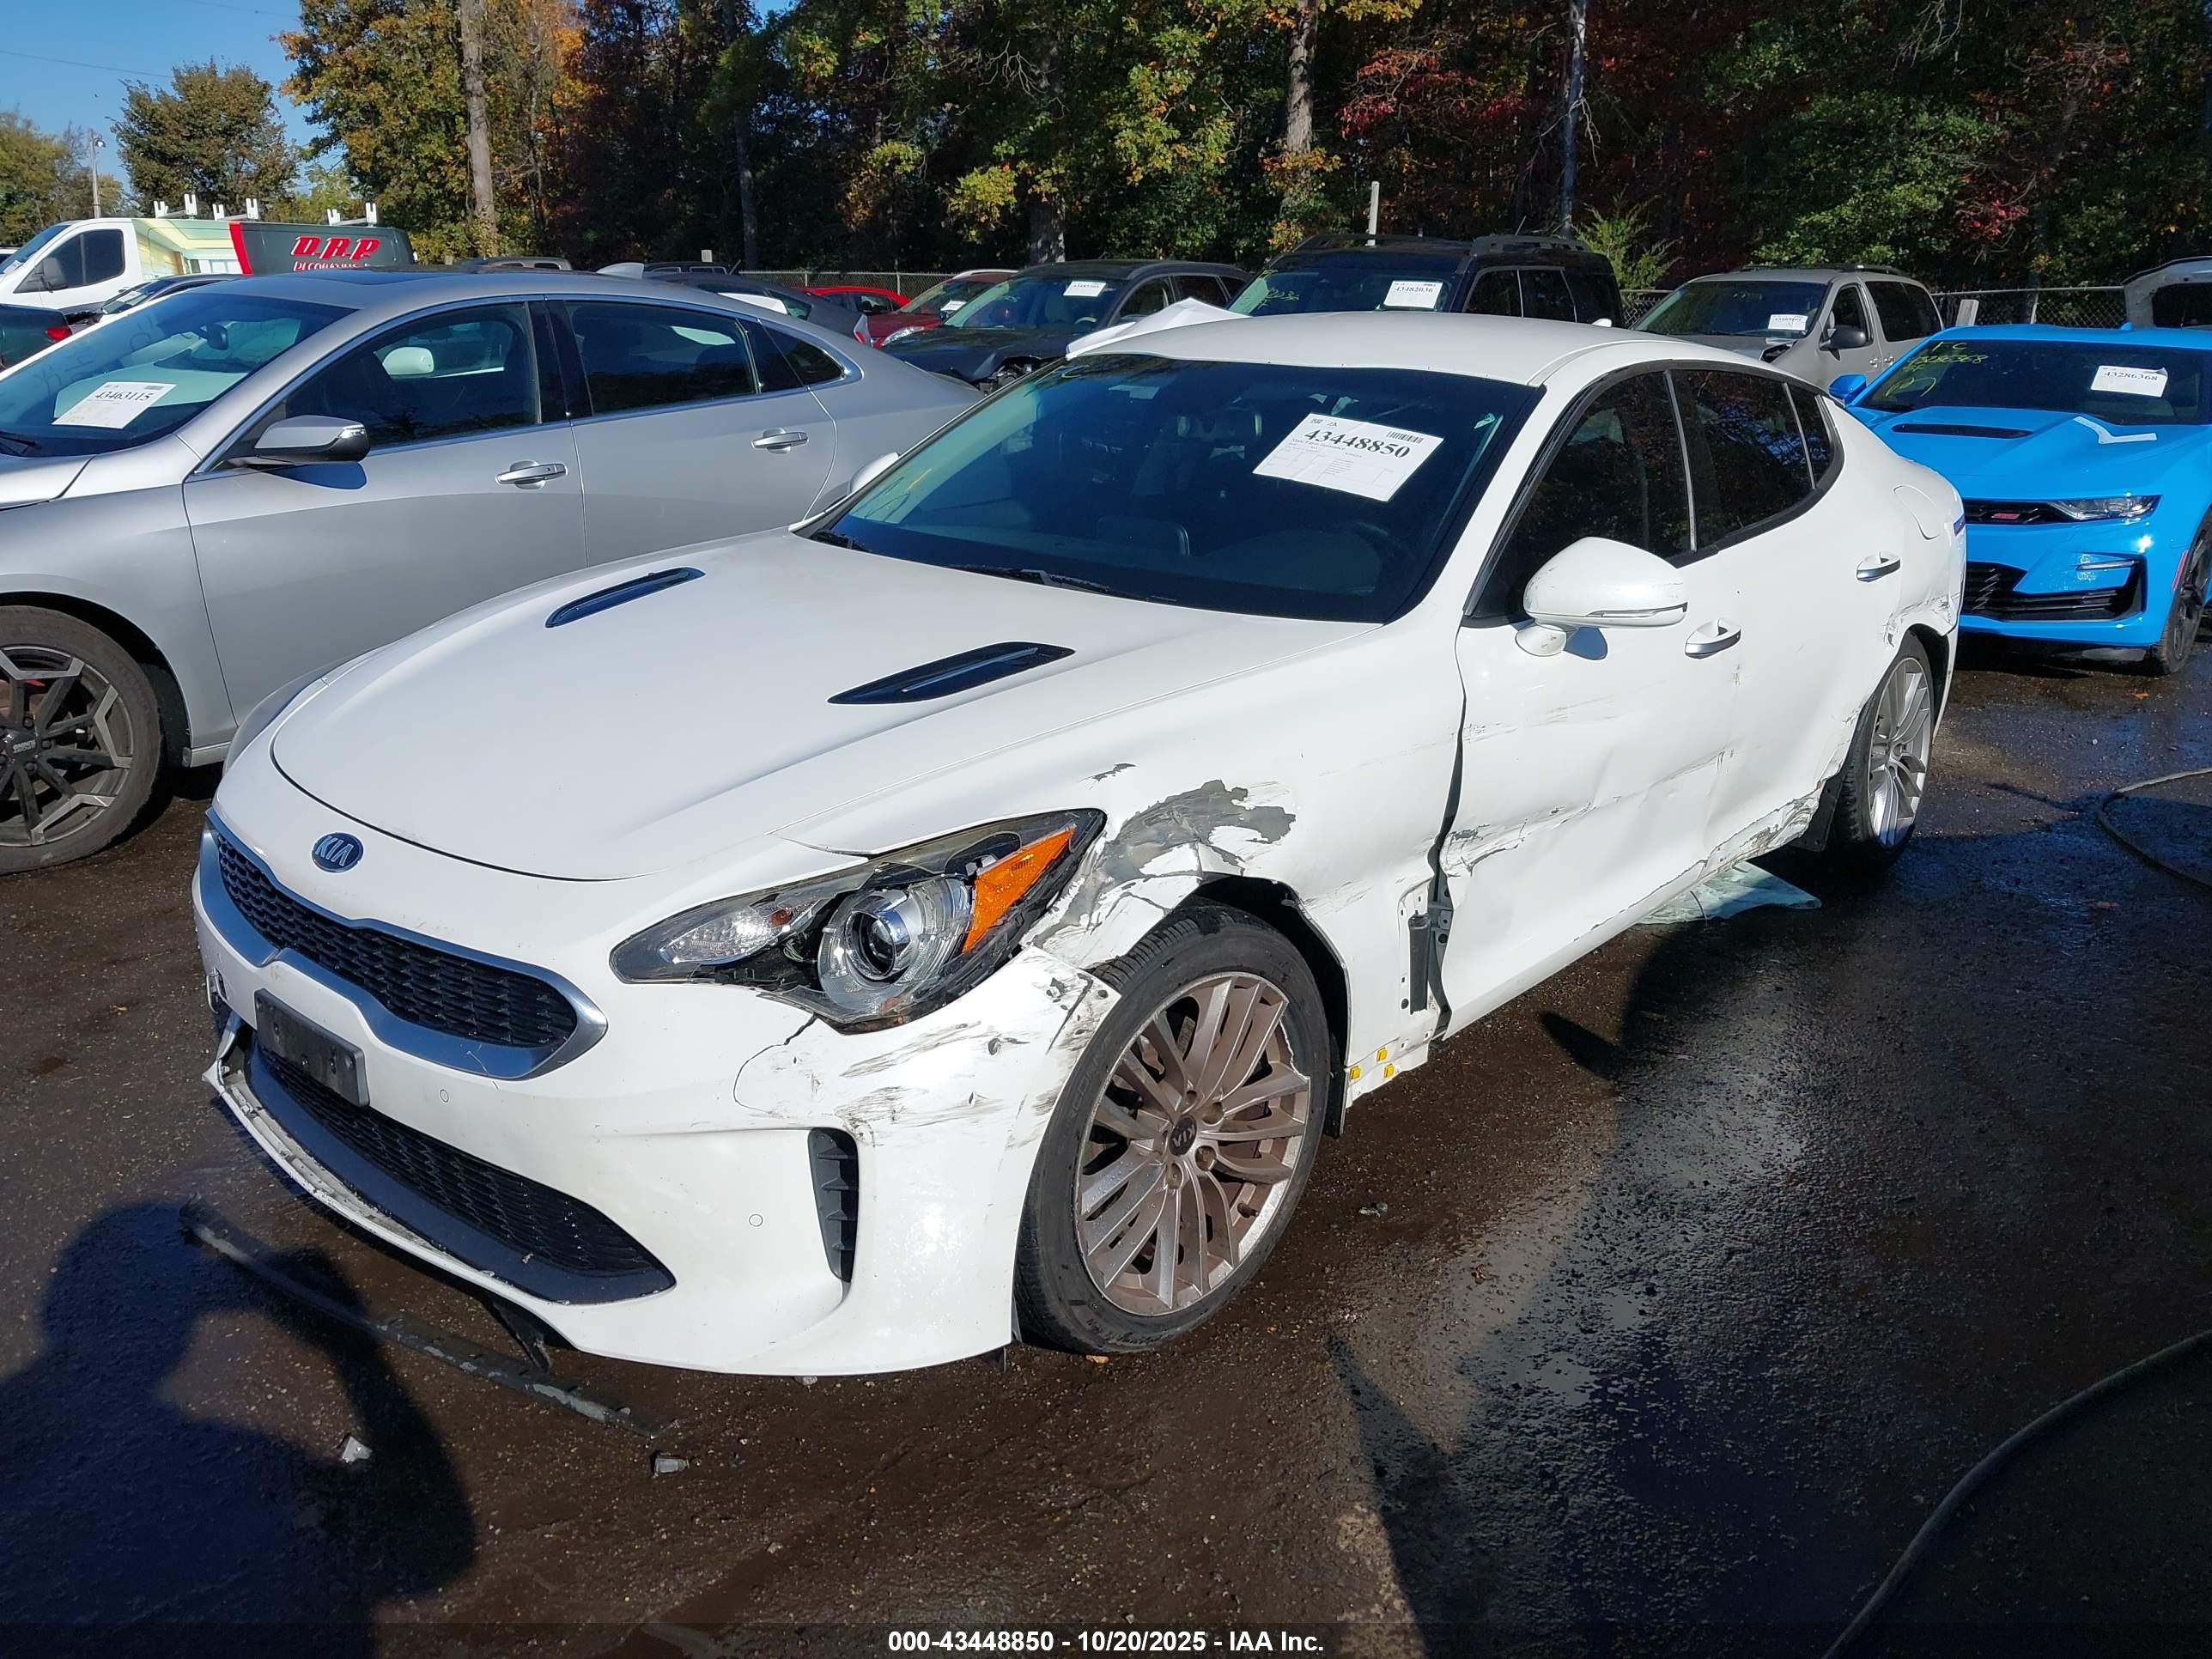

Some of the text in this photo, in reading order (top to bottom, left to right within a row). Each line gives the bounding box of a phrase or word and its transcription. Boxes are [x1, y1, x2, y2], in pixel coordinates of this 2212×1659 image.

[94, 391, 155, 402] 43463115
[1304, 428, 1411, 459] 43448850
[315, 836, 354, 866] KIA
